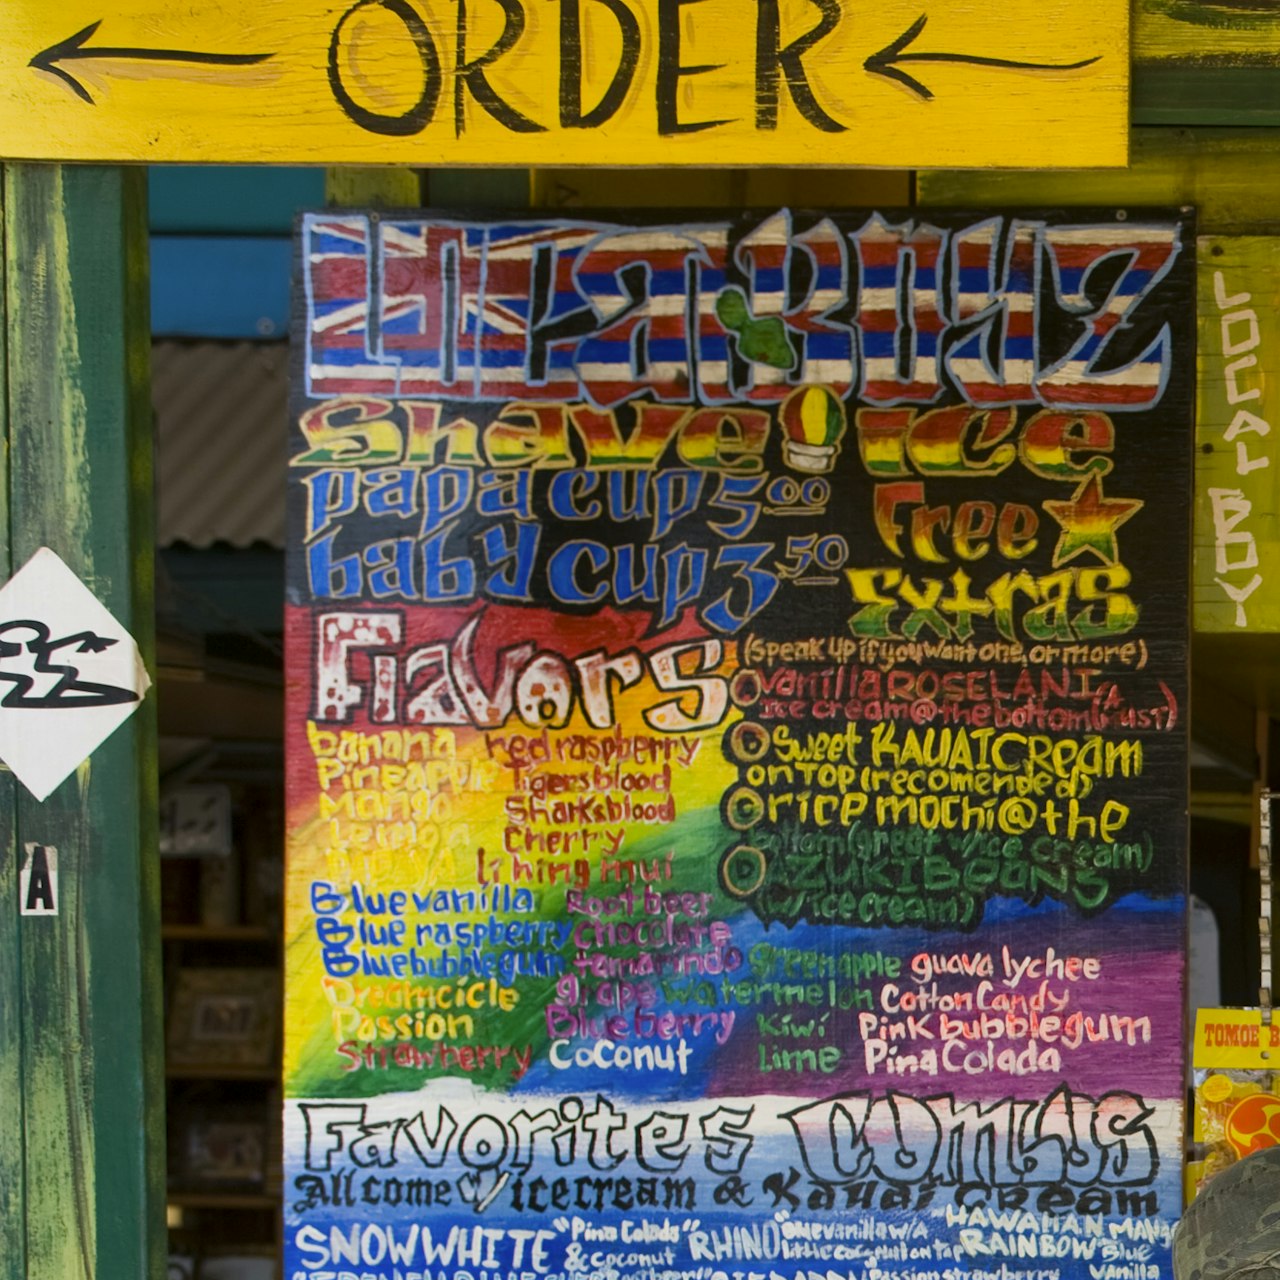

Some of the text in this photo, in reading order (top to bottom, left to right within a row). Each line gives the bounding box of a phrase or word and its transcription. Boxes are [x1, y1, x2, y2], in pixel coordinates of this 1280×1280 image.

[327, 0, 850, 137] ORDER
[1208, 271, 1270, 628] LOCAL BOY
[303, 467, 707, 542] papa cup
[874, 481, 1040, 563] Free
[303, 521, 540, 600] baby
[546, 537, 709, 626] cup
[556, 724, 700, 767] raspberry
[25, 845, 55, 910] A
[317, 917, 406, 947] Blue
[911, 946, 1101, 987] guava lychee
[759, 1045, 841, 1073] Lime
[865, 1039, 1061, 1077] Pina Colada
[1204, 1024, 1260, 1048] TOMOE
